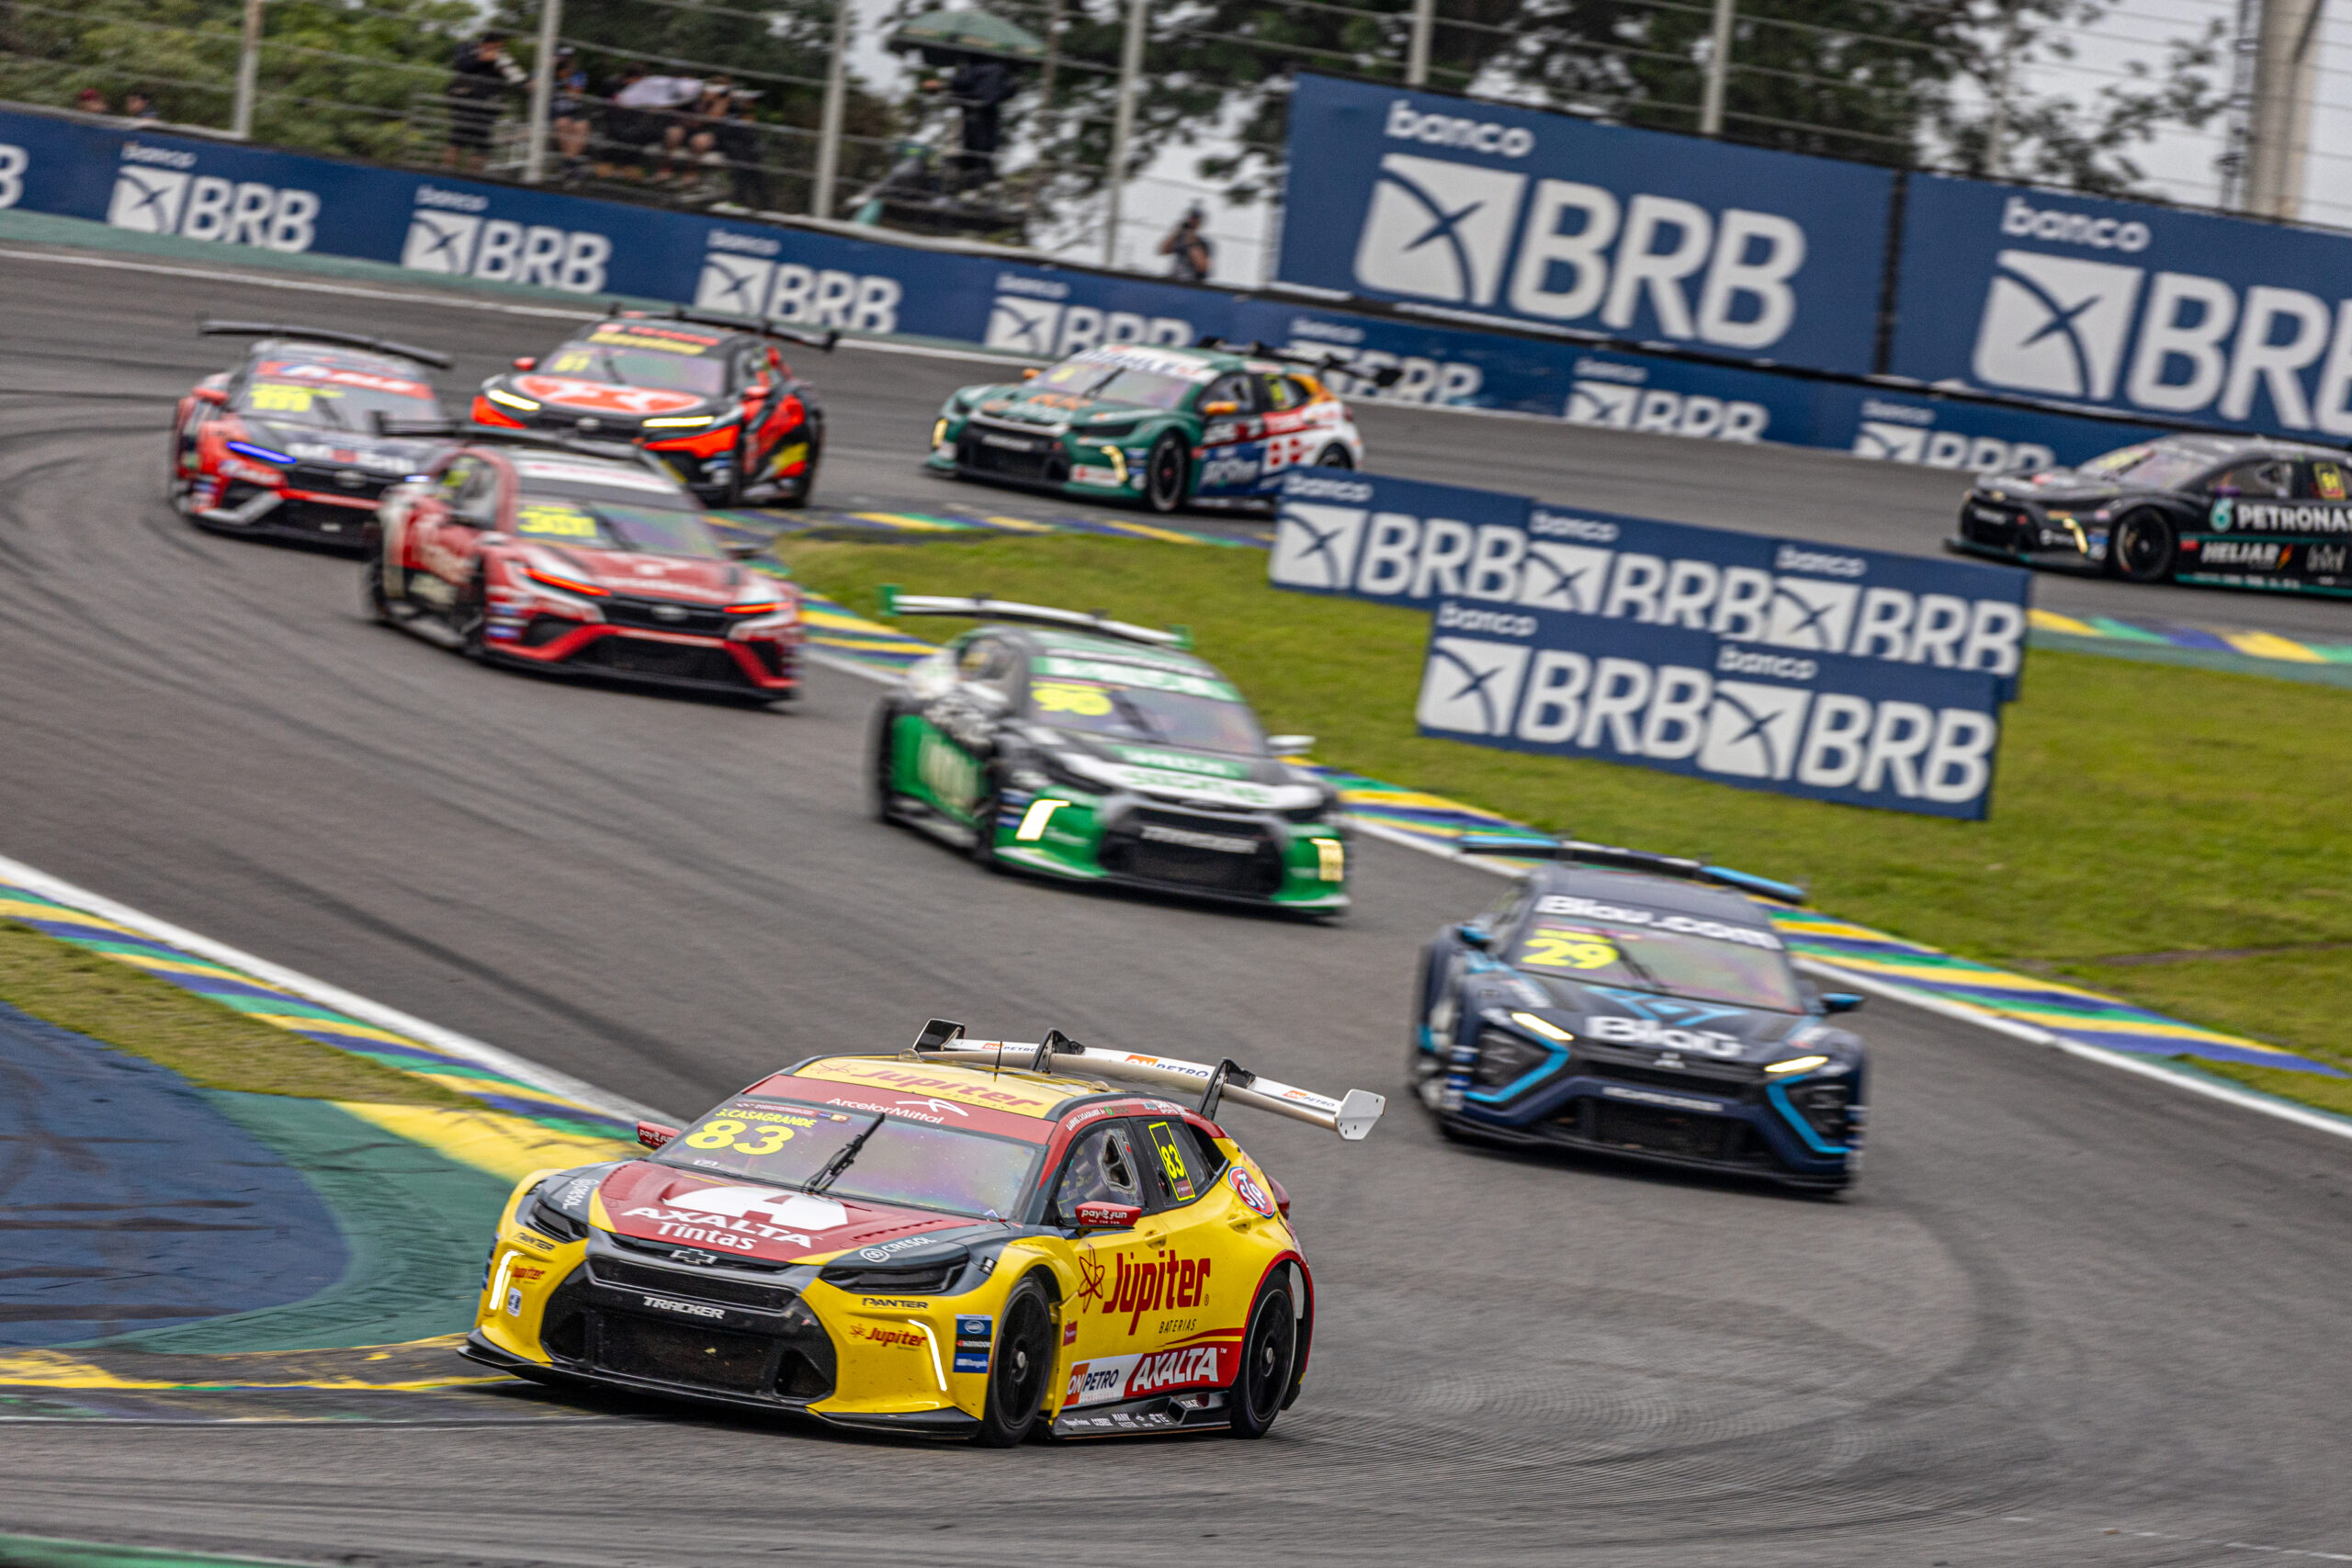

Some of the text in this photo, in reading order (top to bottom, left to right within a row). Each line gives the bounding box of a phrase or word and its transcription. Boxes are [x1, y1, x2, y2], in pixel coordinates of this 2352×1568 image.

[1385, 98, 1535, 159] banco
[182, 175, 320, 254] BRB
[2000, 196, 2152, 253] banco
[473, 219, 613, 295] BRB
[1509, 177, 1807, 350] BRB
[767, 263, 902, 334] BRB
[1288, 473, 1374, 502] banco
[1529, 507, 1621, 543] banco
[1355, 512, 1528, 602] BRB
[1775, 545, 1867, 578] banco
[1438, 601, 1538, 637] banco
[1717, 643, 1819, 680] banco
[1517, 648, 1715, 759] BRB
[1795, 692, 1998, 803] BRB
[1521, 937, 1620, 970] 29
[826, 1097, 945, 1125] ArcelorMittal
[685, 1119, 796, 1156] 83
[1160, 1144, 1185, 1179] 83
[1237, 1172, 1268, 1211] STP
[620, 1206, 812, 1249] AXALTA
[656, 1221, 758, 1251] Tintas
[881, 1235, 937, 1253] CRESOL
[643, 1295, 726, 1320] TRACKER
[862, 1297, 929, 1310] PANTER
[1158, 1318, 1197, 1335] BATERIAS
[1131, 1346, 1219, 1393] AXALTA
